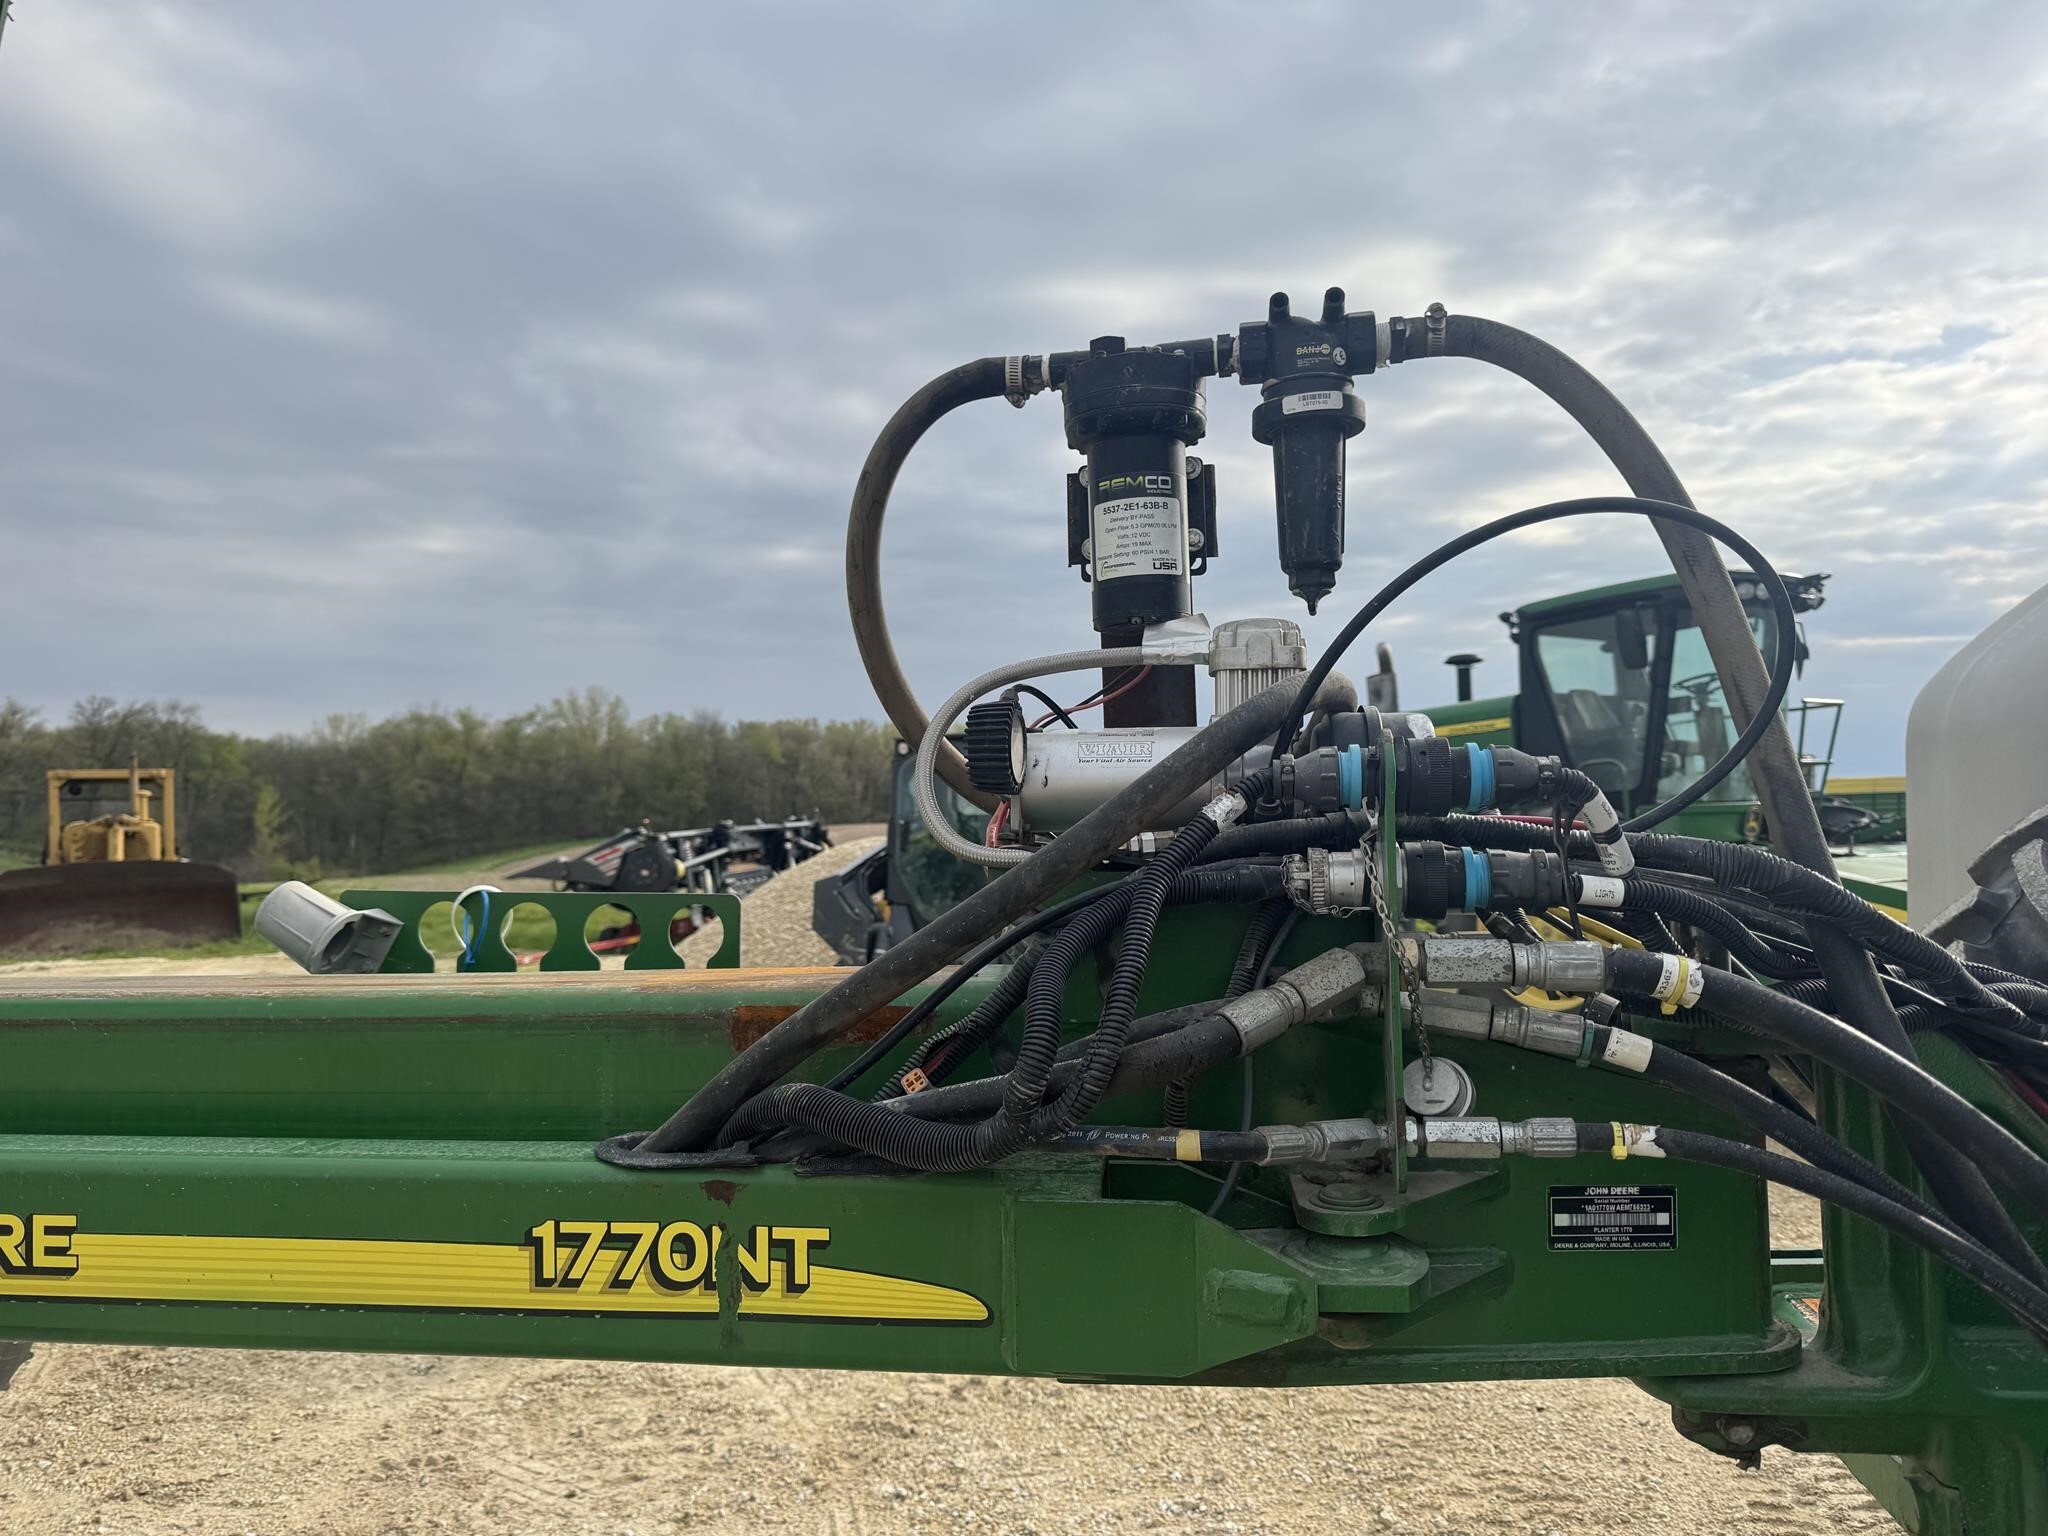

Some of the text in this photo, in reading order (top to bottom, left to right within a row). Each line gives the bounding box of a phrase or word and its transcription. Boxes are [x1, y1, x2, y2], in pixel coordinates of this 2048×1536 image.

[1098, 476, 1171, 490] REMCO
[1103, 502, 1168, 515] 5537-2E1-63B-B
[1153, 562, 1177, 570] USA
[1080, 743, 1151, 756] VIAIR
[1585, 1187, 1640, 1196] JOHN DEERE
